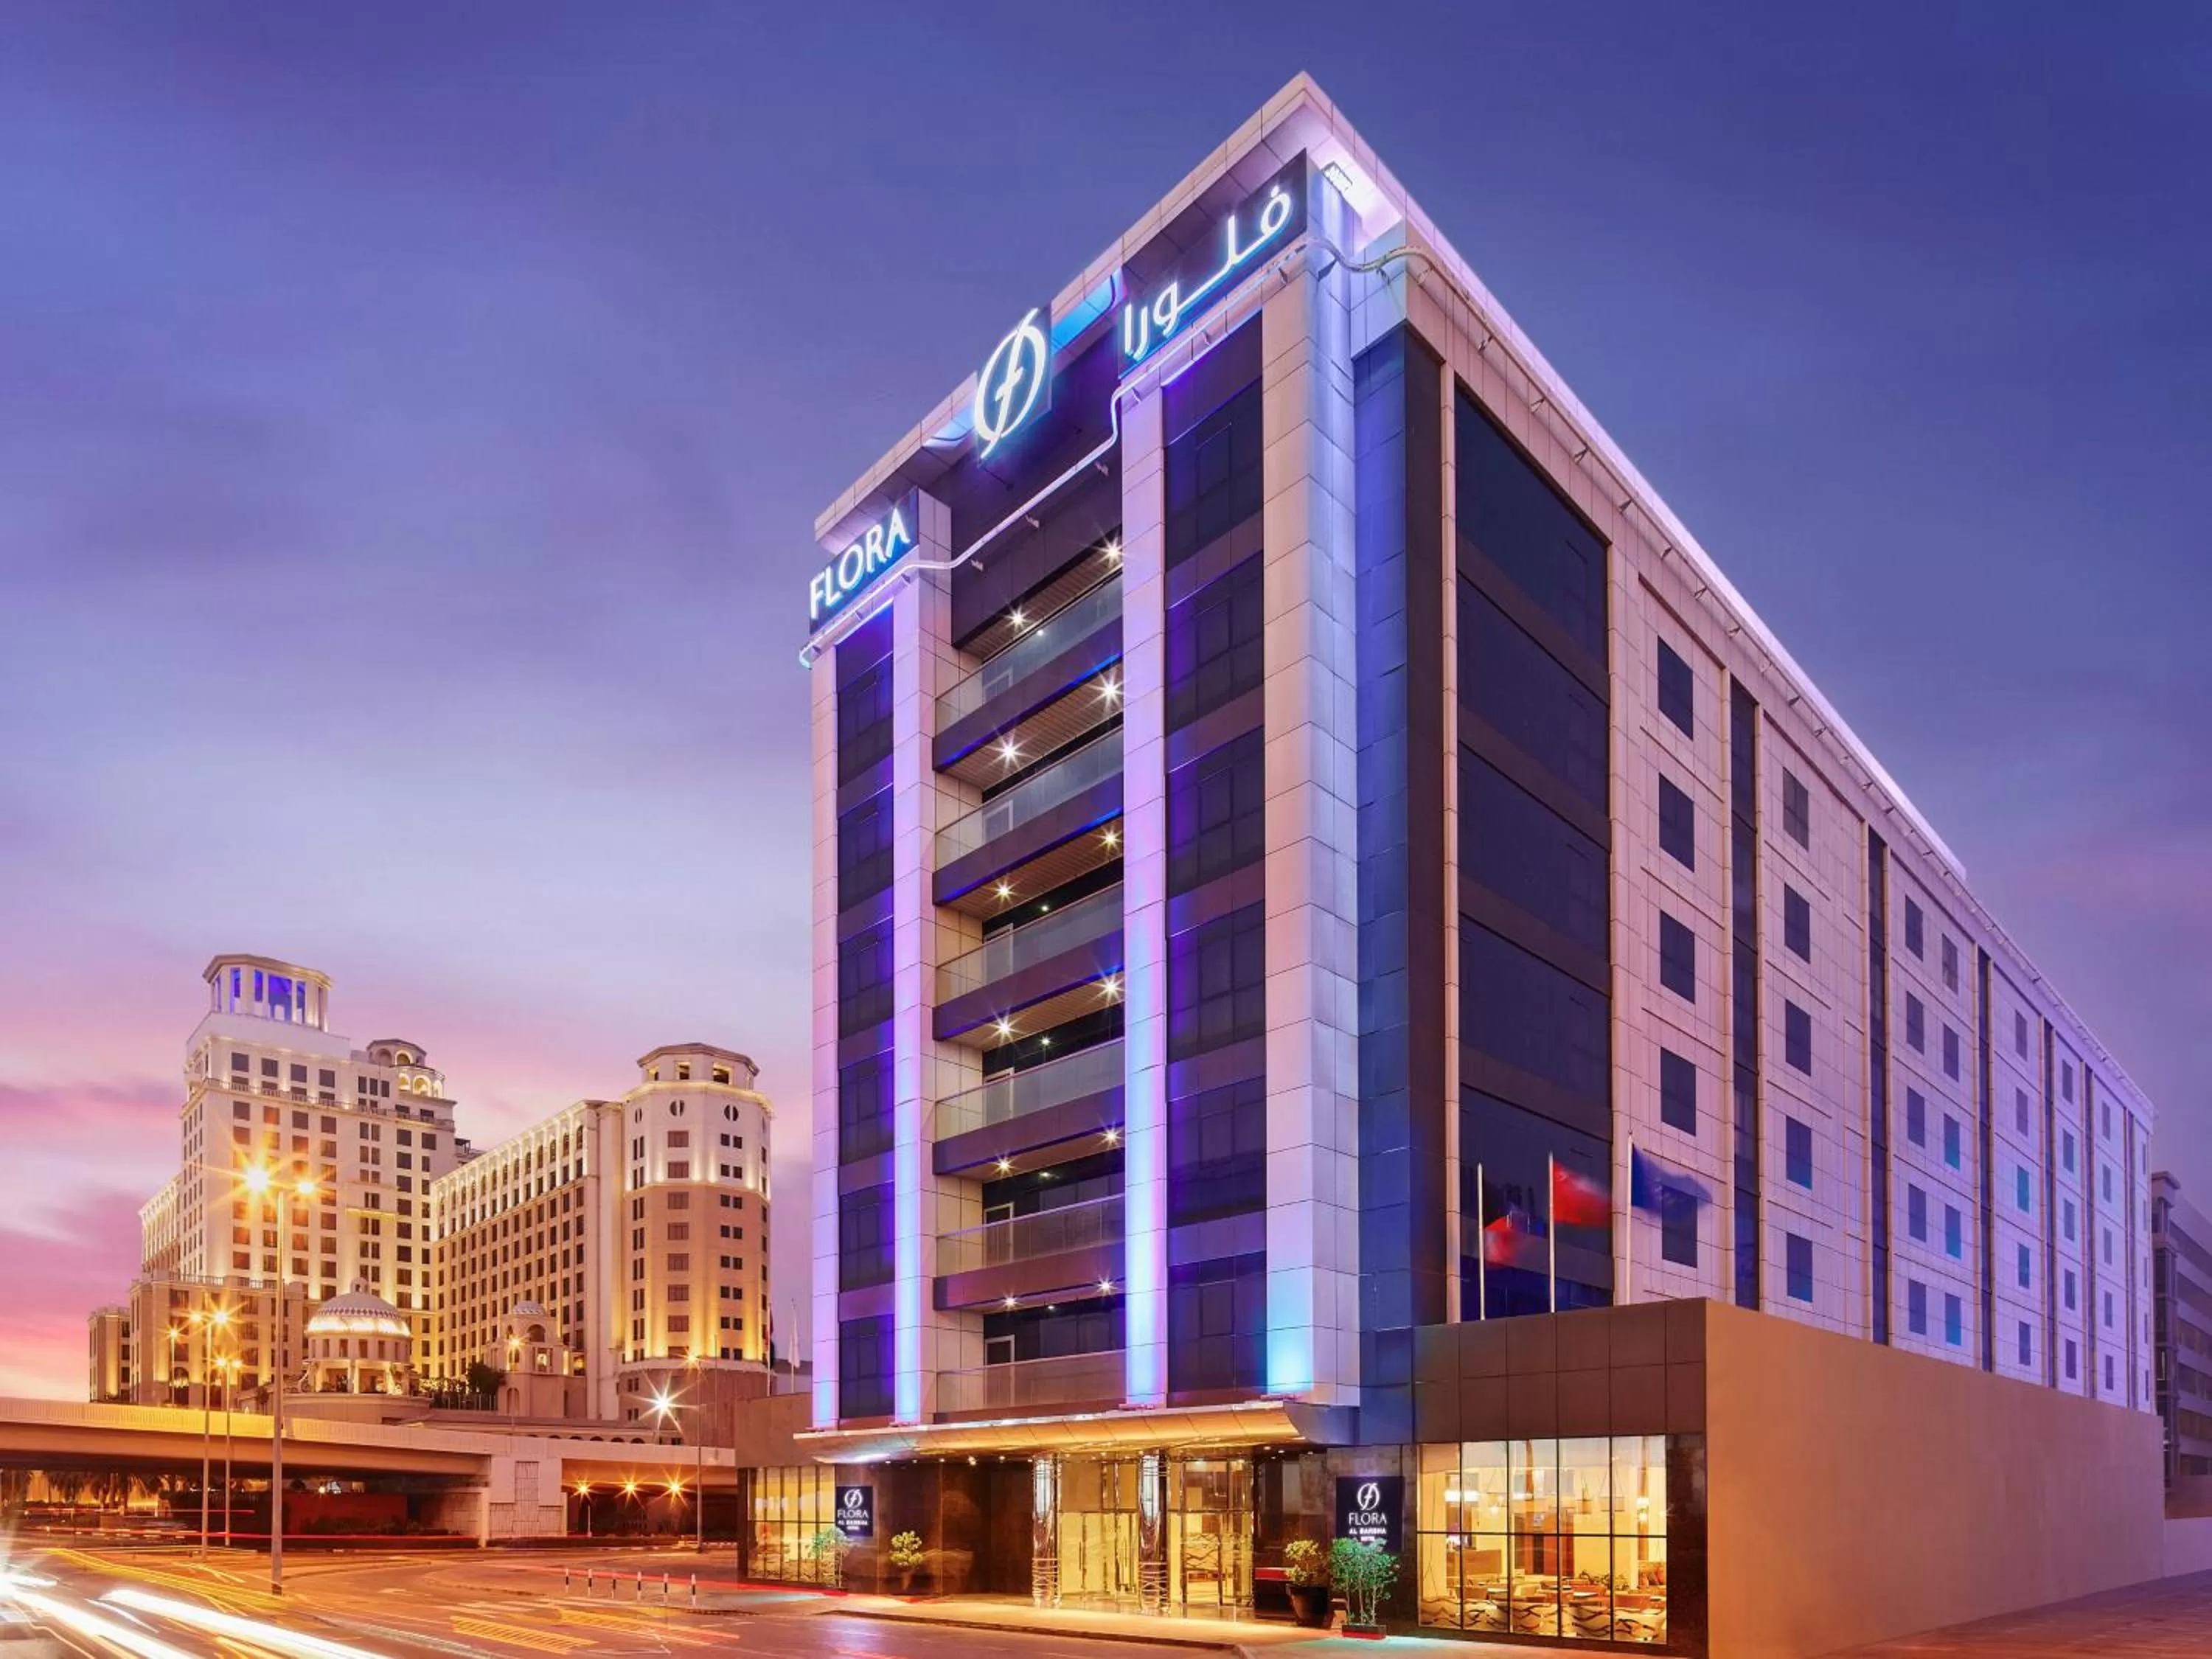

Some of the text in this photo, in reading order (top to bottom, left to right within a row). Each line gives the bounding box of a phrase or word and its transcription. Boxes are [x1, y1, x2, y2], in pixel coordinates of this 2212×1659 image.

[810, 507, 911, 619] FLORA
[837, 1509, 869, 1518] FLORA
[1349, 1512, 1387, 1526] FLORA
